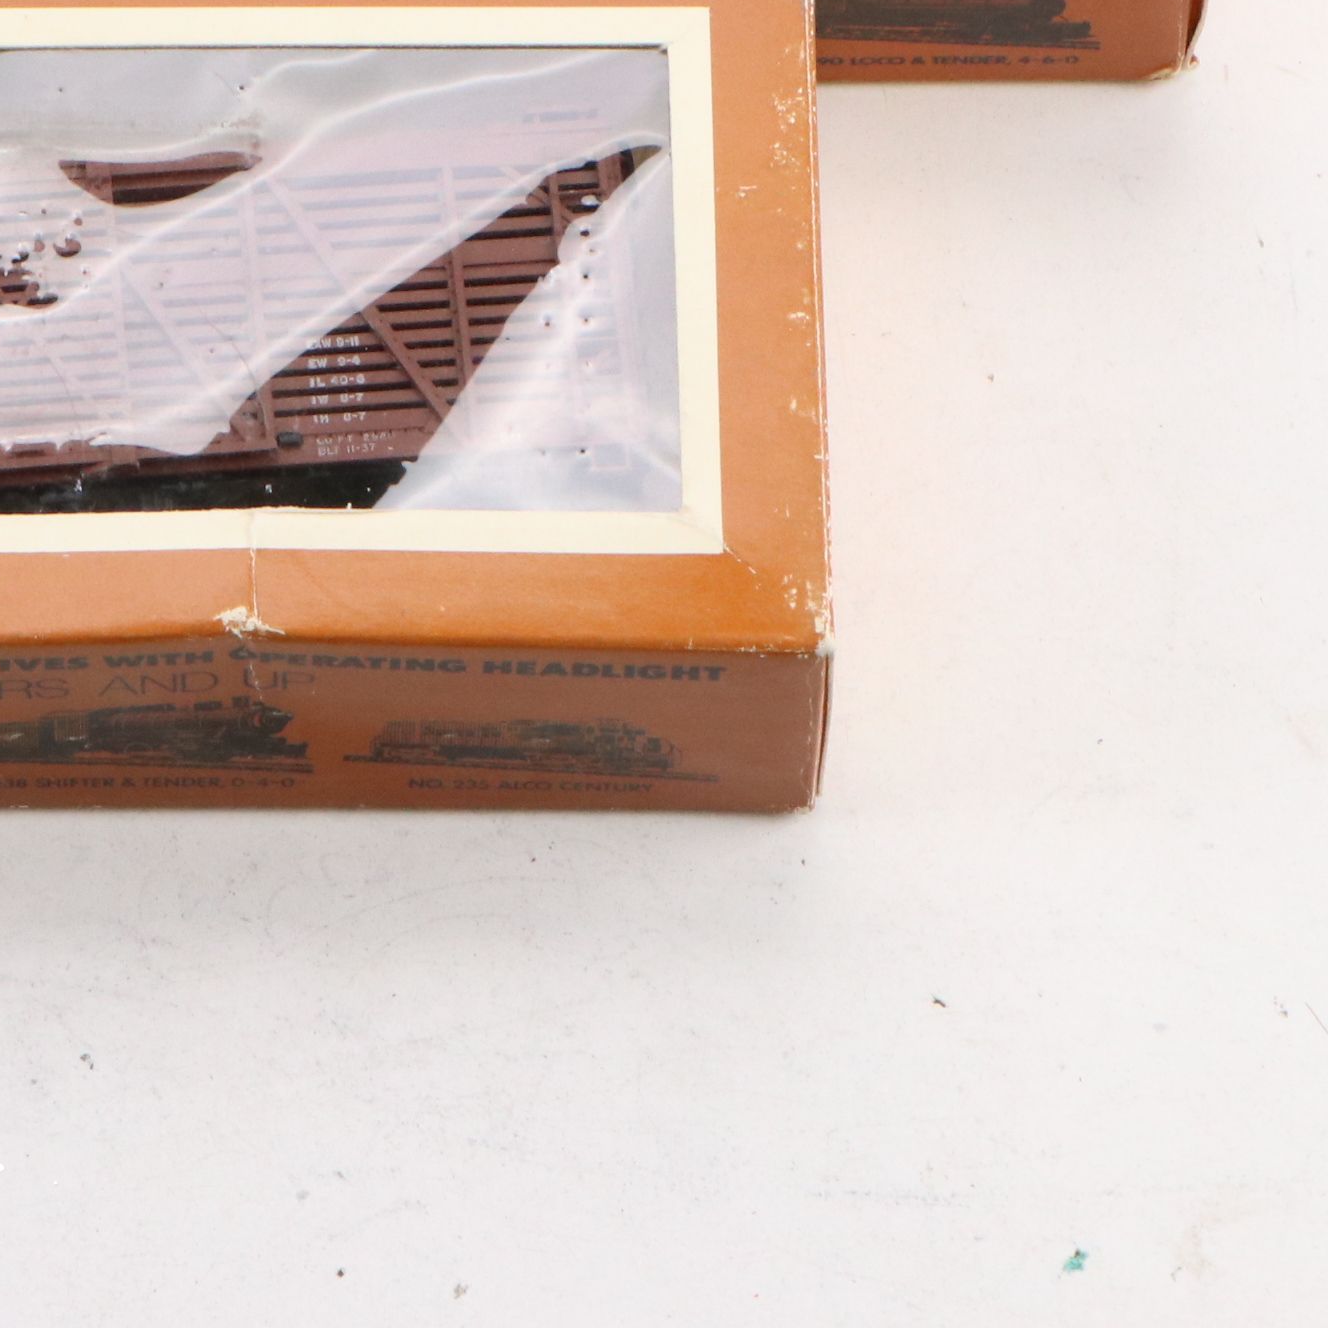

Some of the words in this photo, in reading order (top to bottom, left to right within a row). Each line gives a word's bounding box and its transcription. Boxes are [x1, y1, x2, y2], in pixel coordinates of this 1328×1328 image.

[103, 650, 214, 668] WITH
[229, 646, 467, 673] OPERATING
[482, 659, 727, 682] HEADLIGHT
[98, 672, 218, 697] AND
[243, 667, 317, 691] UP
